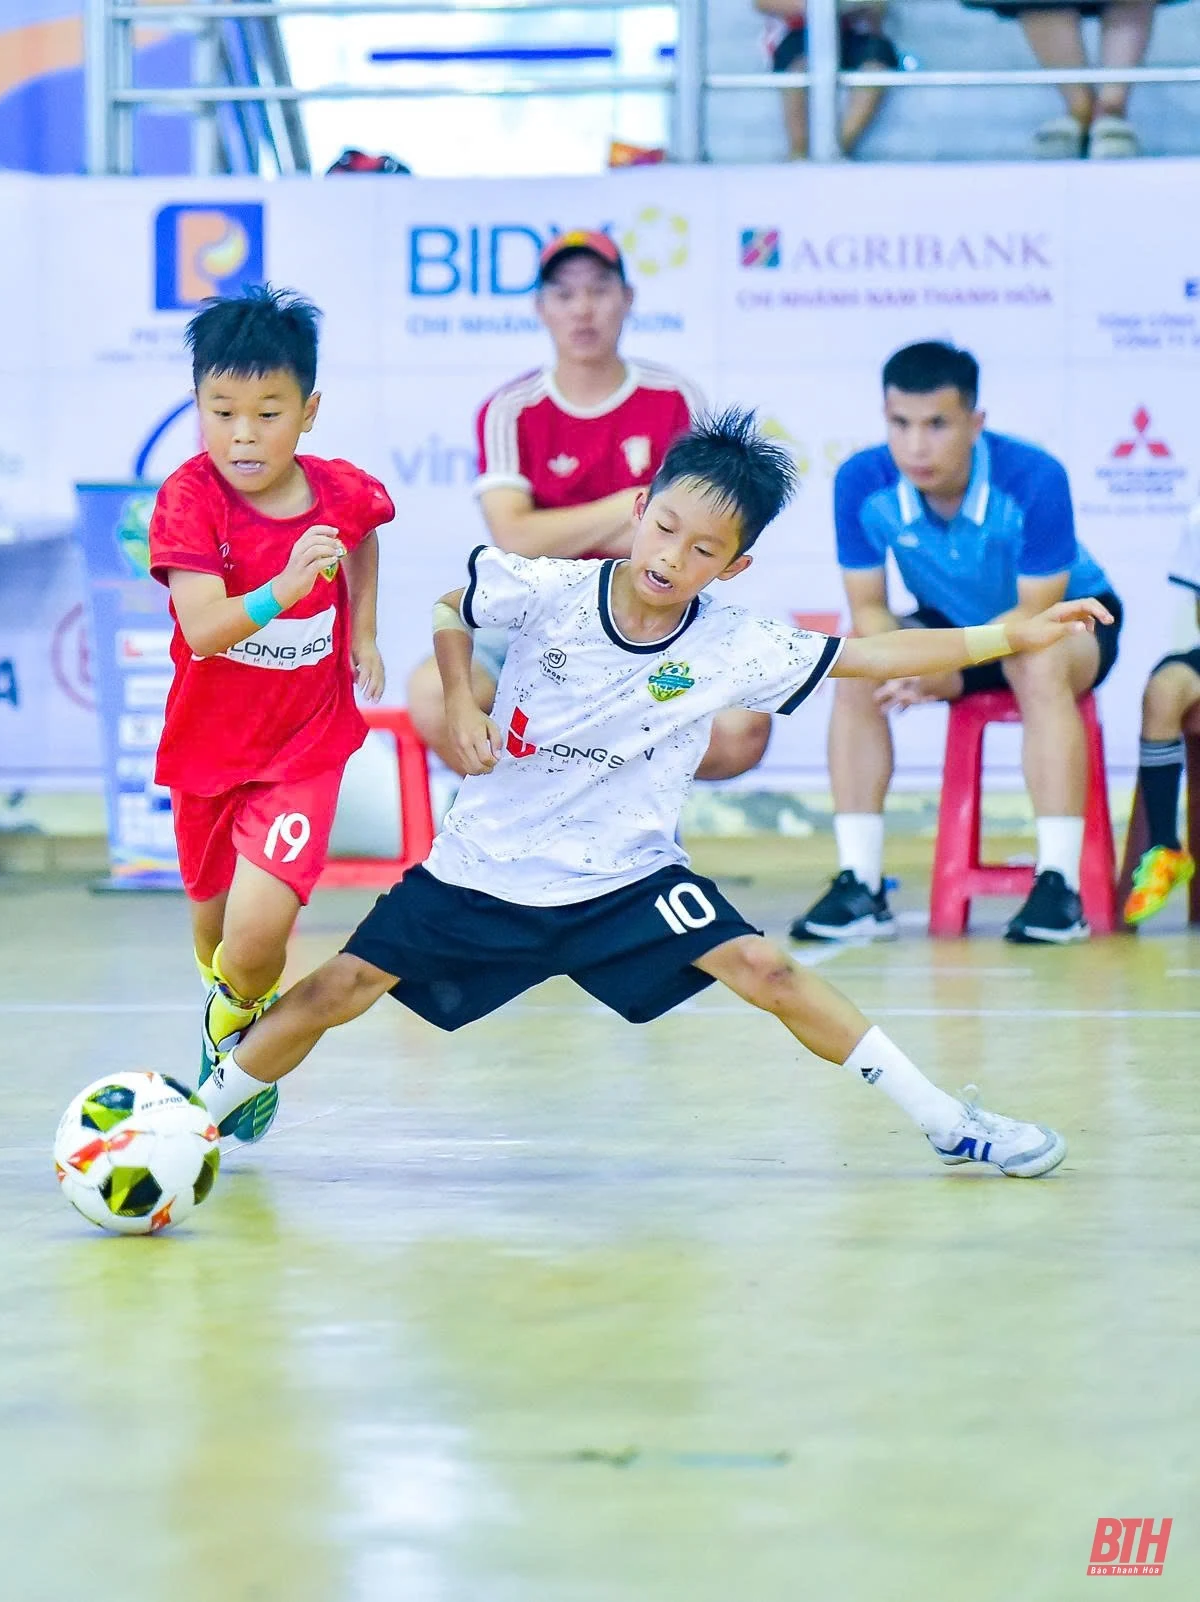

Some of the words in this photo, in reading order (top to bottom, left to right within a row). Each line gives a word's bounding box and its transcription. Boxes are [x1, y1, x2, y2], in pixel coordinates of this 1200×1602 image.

[409, 224, 612, 296] BID
[793, 233, 1052, 270] AGRIBANK
[231, 641, 297, 659] LONG
[264, 812, 311, 863] 19
[654, 882, 716, 935] 10
